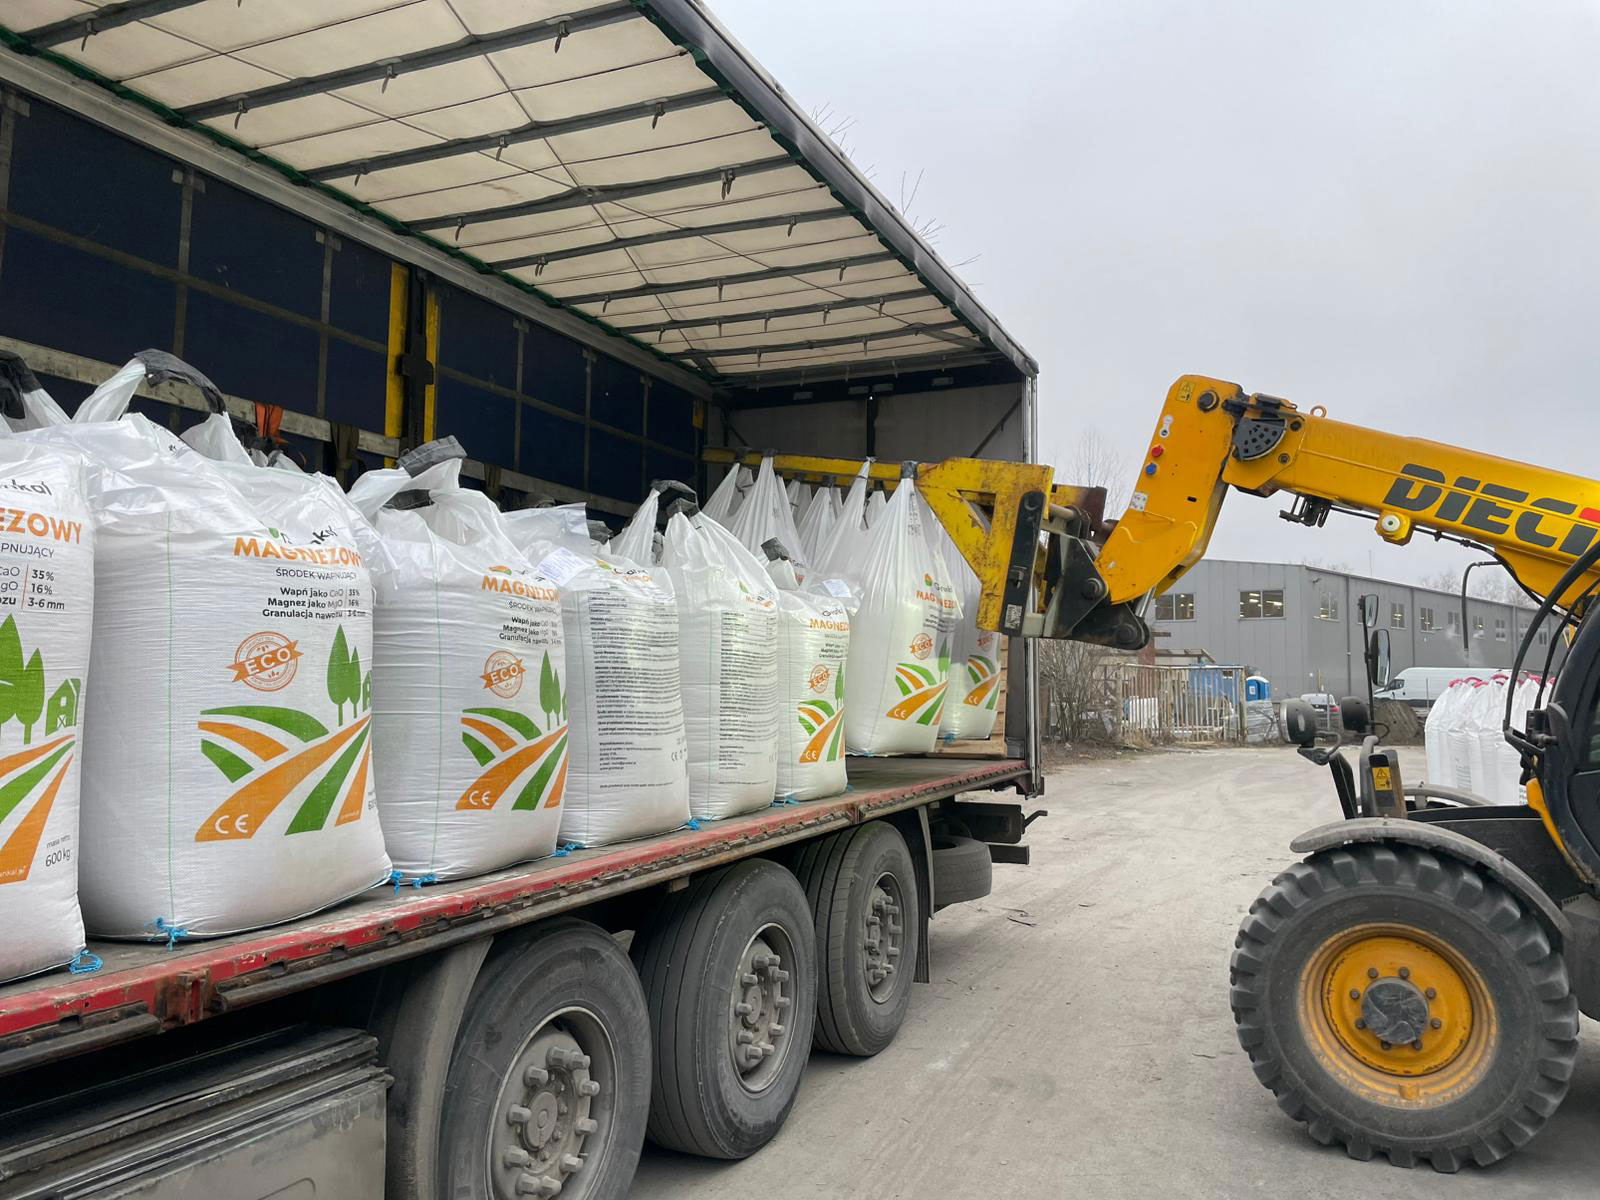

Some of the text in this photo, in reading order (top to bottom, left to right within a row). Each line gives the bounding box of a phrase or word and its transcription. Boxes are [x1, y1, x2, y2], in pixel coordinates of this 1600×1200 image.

[1382, 463, 1600, 556] DIECI
[31, 568, 55, 582] 35%
[275, 566, 316, 580] ŚRODEK
[31, 582, 53, 596] 16%
[280, 586, 308, 600] Wapń
[309, 587, 328, 599] jako
[0, 596, 66, 611] zu 3-6 mm
[267, 597, 307, 609] Magnez
[307, 598, 327, 609] jako
[262, 608, 314, 620] Granulacja
[245, 647, 291, 676] ECO
[489, 665, 519, 684] ECO
[469, 790, 491, 806] CE
[214, 813, 250, 835] CE
[45, 847, 71, 868] 600 kg
